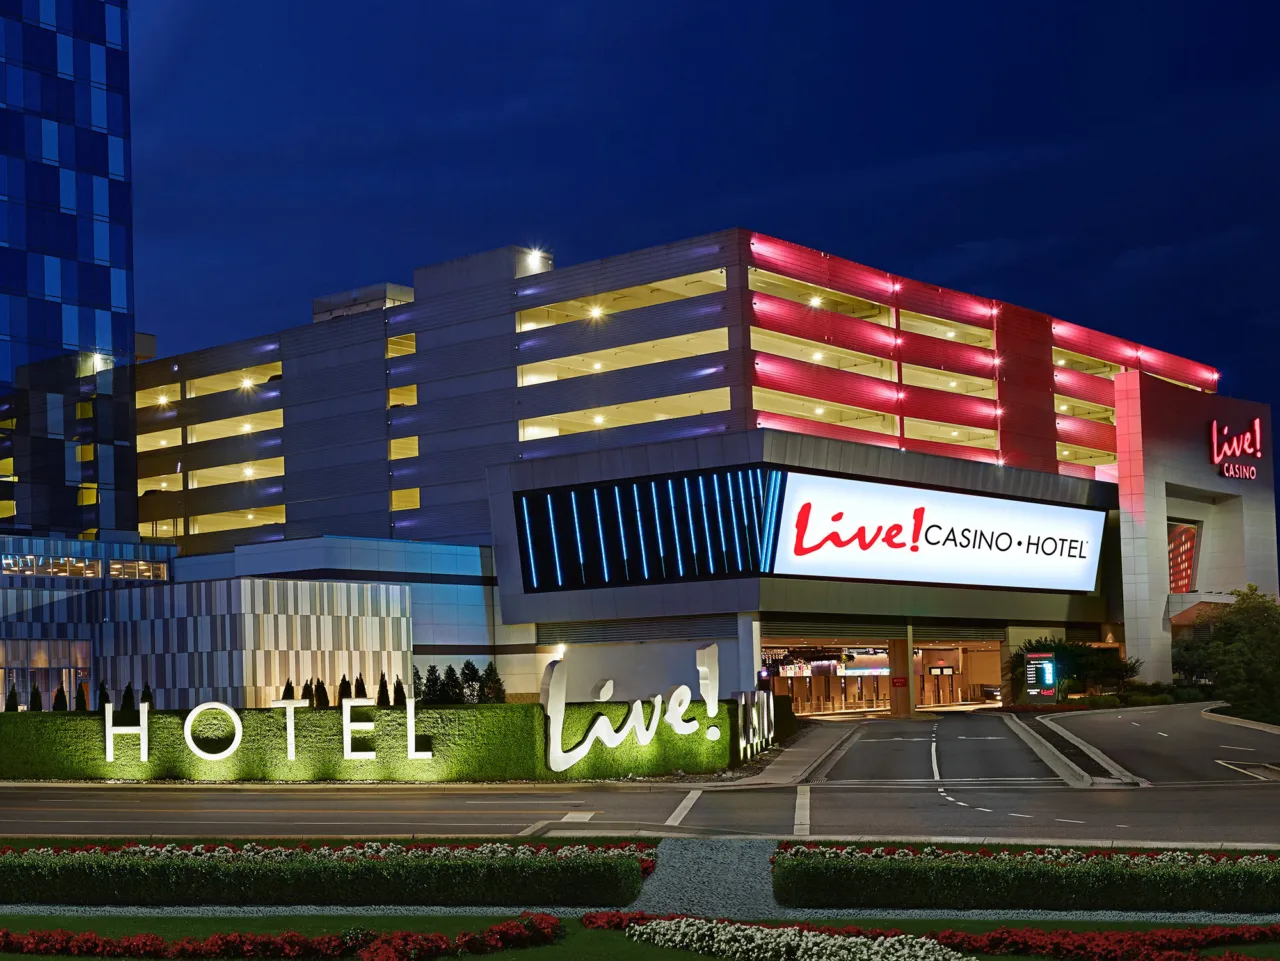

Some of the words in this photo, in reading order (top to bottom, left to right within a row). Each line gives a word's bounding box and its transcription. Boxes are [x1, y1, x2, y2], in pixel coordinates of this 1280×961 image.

[1211, 417, 1263, 465] Live!
[1223, 462, 1257, 480] CASINO
[793, 501, 925, 557] Live!
[924, 524, 1013, 552] CASINO
[1025, 534, 1087, 559] HOTEL
[104, 696, 434, 763] HOTEL
[542, 642, 721, 772] Live!
